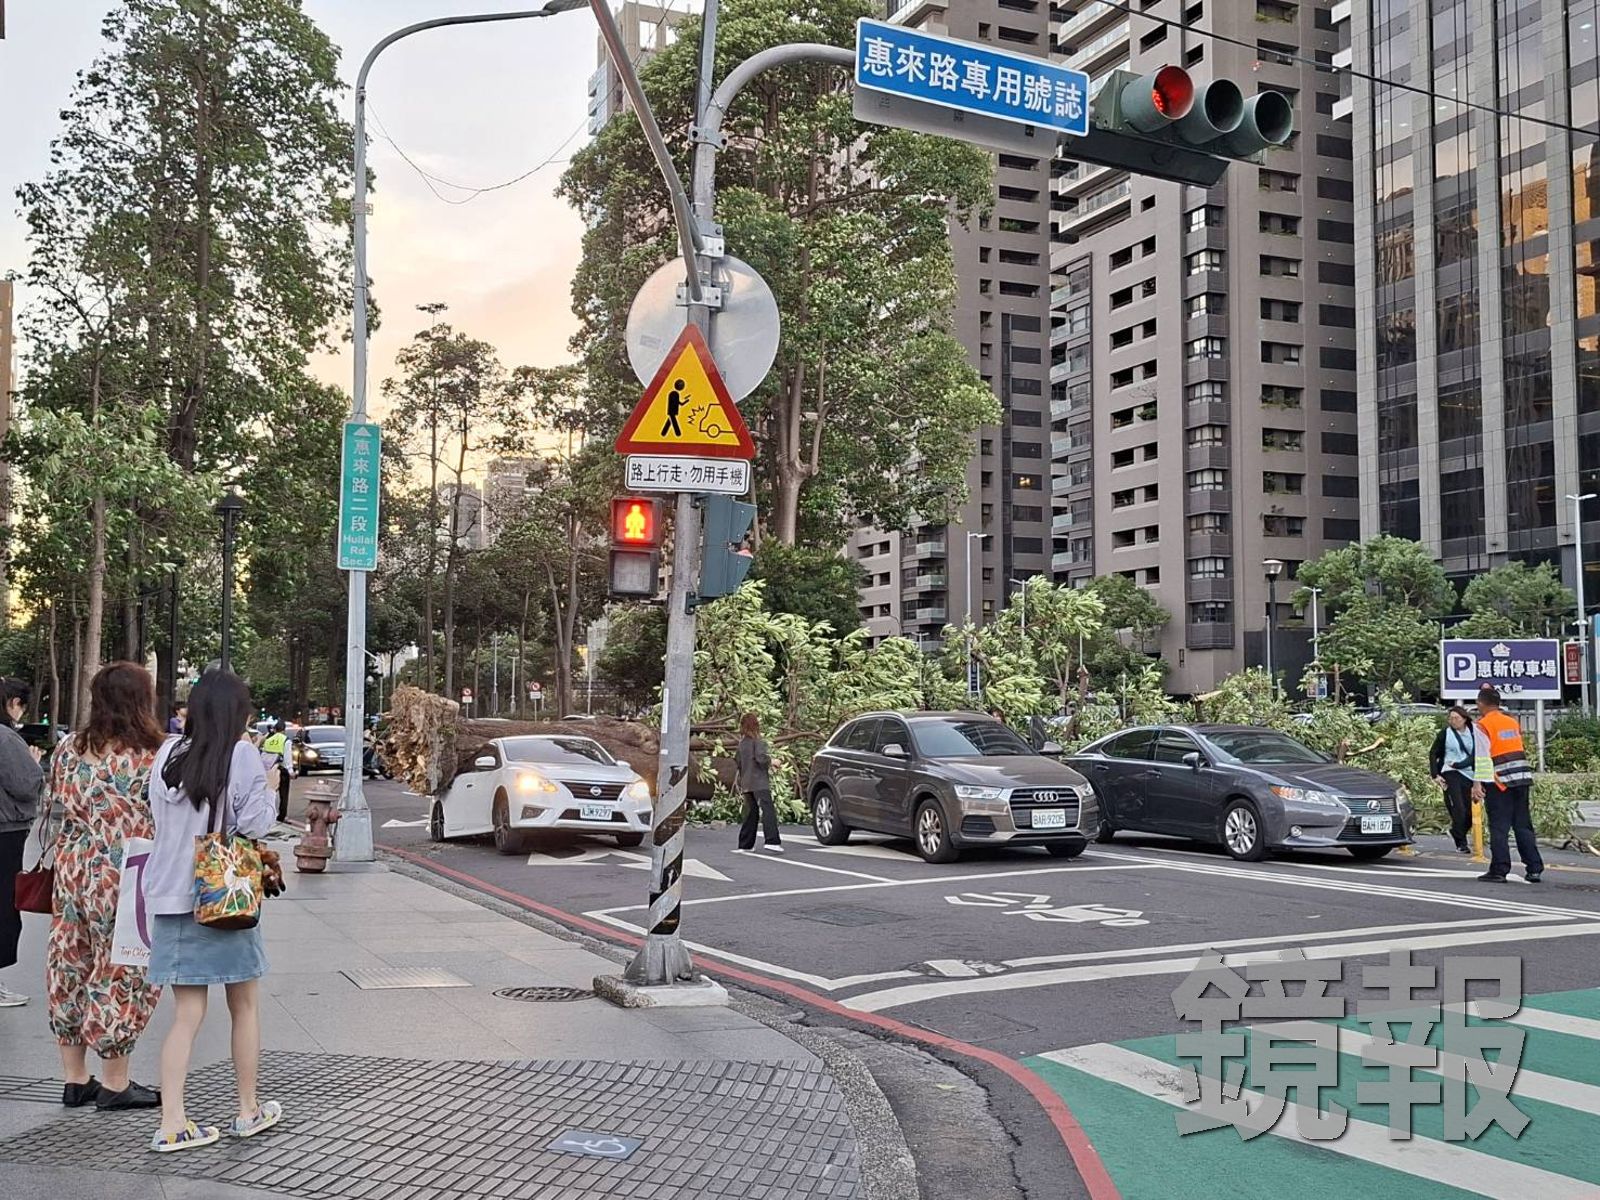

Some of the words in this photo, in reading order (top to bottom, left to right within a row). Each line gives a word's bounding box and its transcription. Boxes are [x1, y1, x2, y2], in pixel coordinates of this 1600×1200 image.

[863, 37, 1082, 120] 惠來路專用號誌
[351, 439, 370, 532] 惠來路二段
[343, 534, 374, 545] Huilai
[1454, 657, 1472, 678] P
[1477, 659, 1557, 678] 惠新停車場
